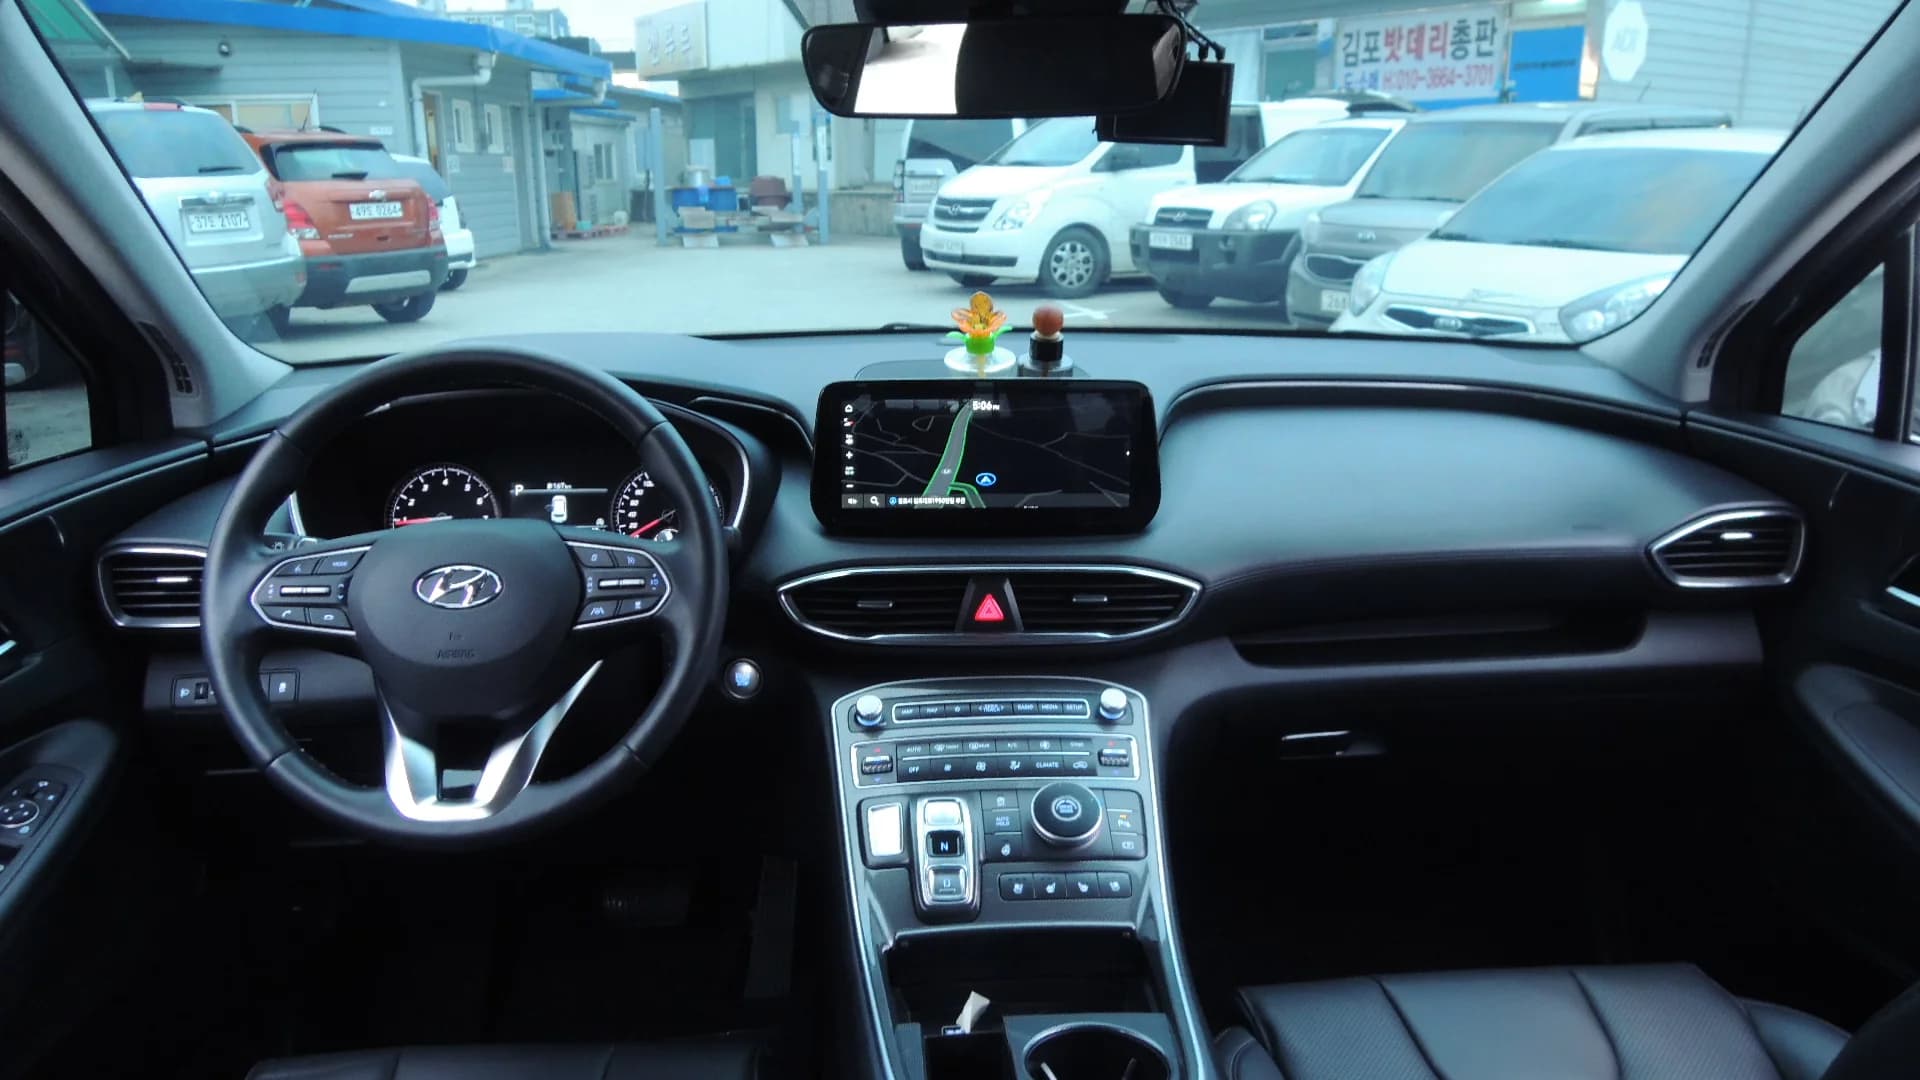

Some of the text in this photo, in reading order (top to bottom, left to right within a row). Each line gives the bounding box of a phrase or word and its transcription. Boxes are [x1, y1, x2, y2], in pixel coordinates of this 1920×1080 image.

[218, 213, 242, 227] 2107
[972, 400, 993, 411] 5:06
[514, 484, 524, 497] P
[908, 766, 920, 774] OFF
[1035, 761, 1060, 769] CLIMATE
[940, 841, 949, 850] N
